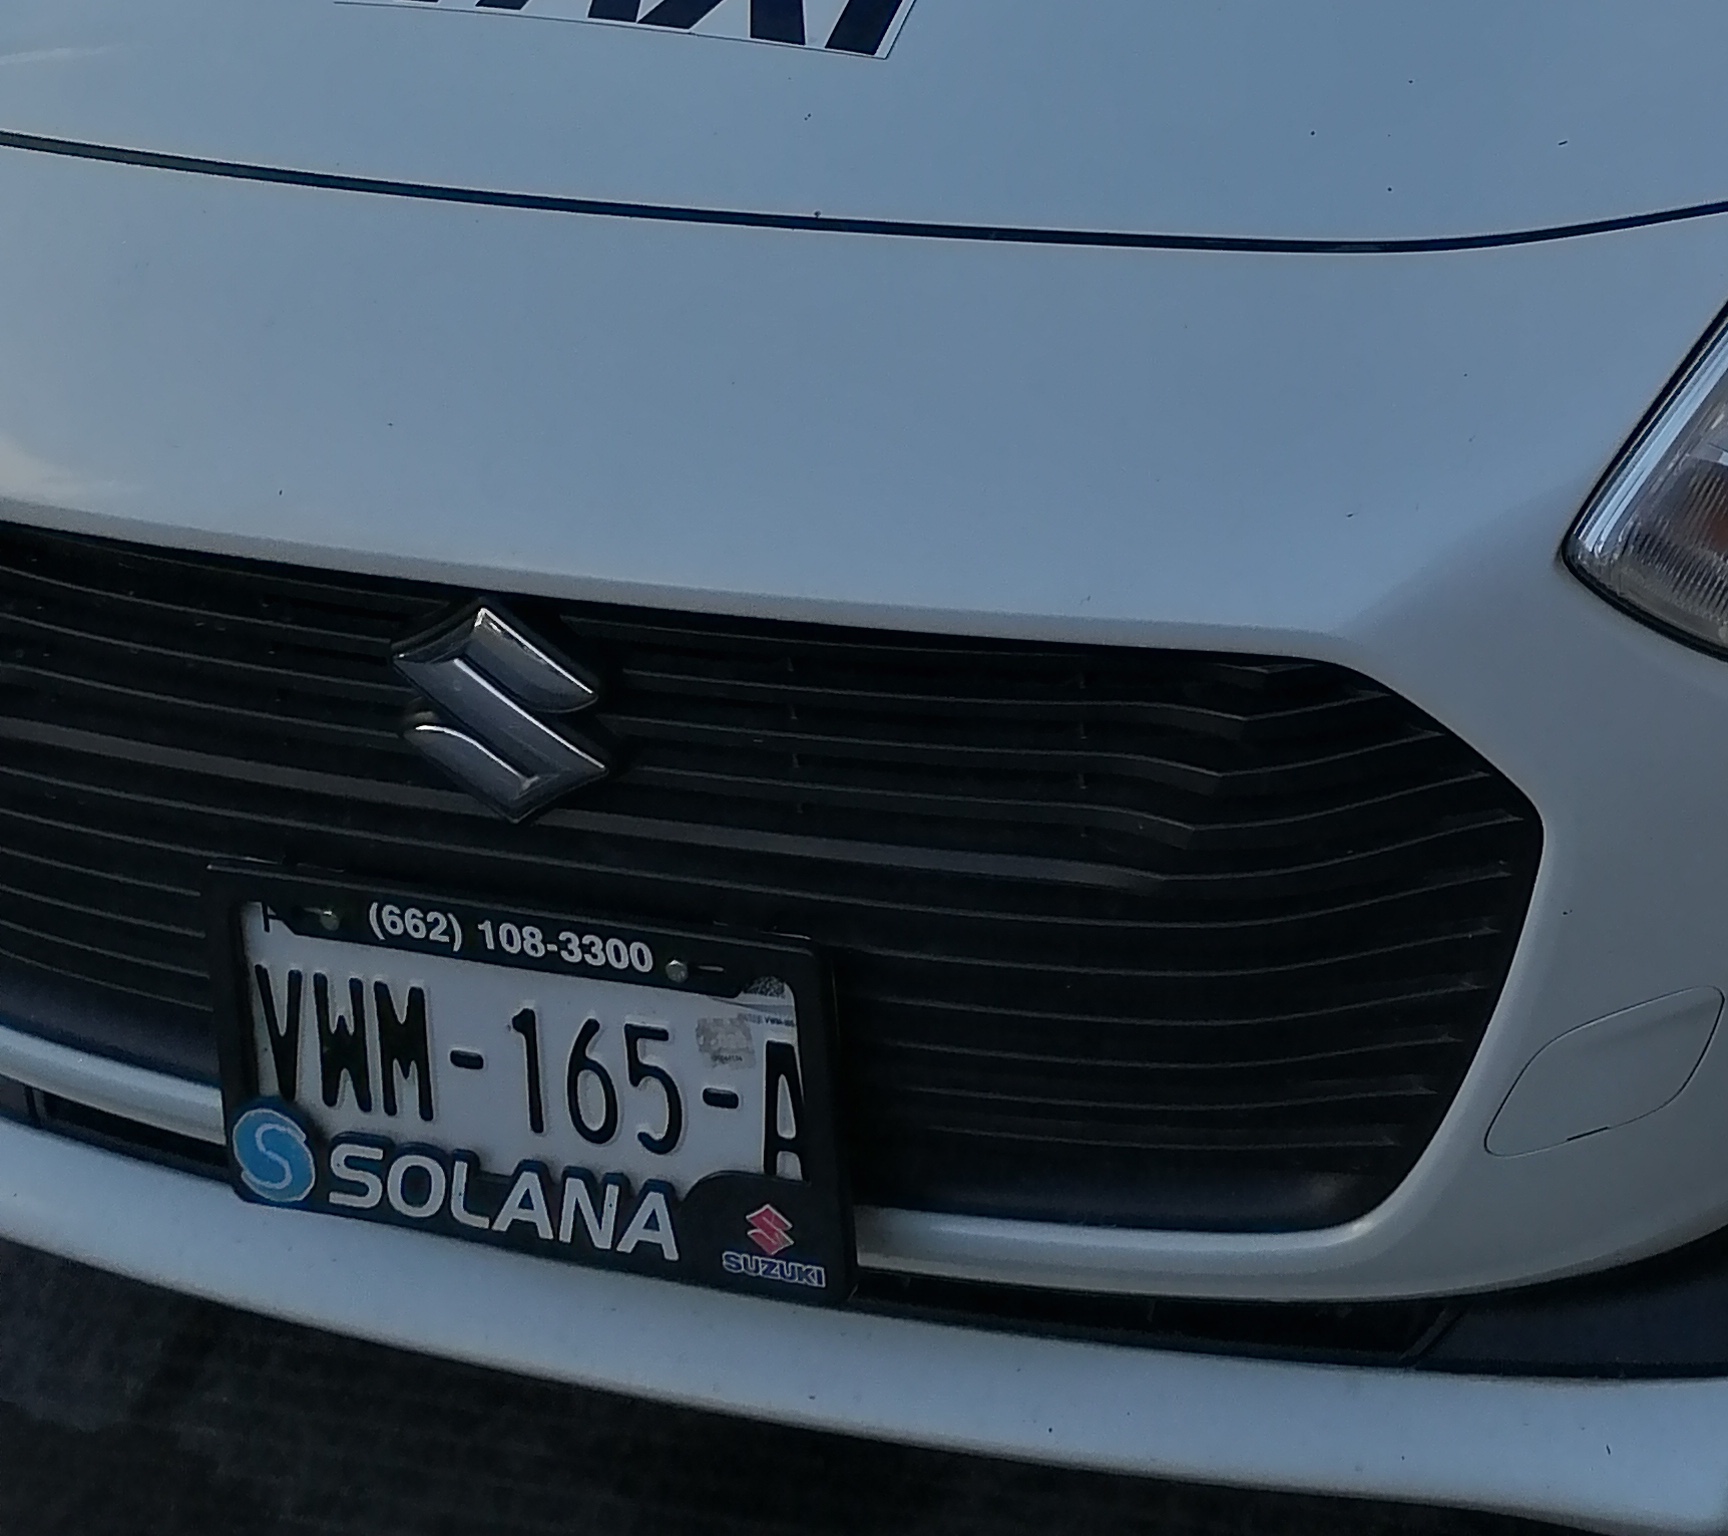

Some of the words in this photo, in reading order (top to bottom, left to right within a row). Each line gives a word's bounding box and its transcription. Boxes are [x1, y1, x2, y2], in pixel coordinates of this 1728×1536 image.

[368, 901, 463, 953] (662)
[477, 919, 655, 974] 108-3300
[254, 963, 804, 1182] VWM-165-A
[328, 1141, 681, 1262] SOLANA
[721, 1250, 827, 1289] SUZUKI
